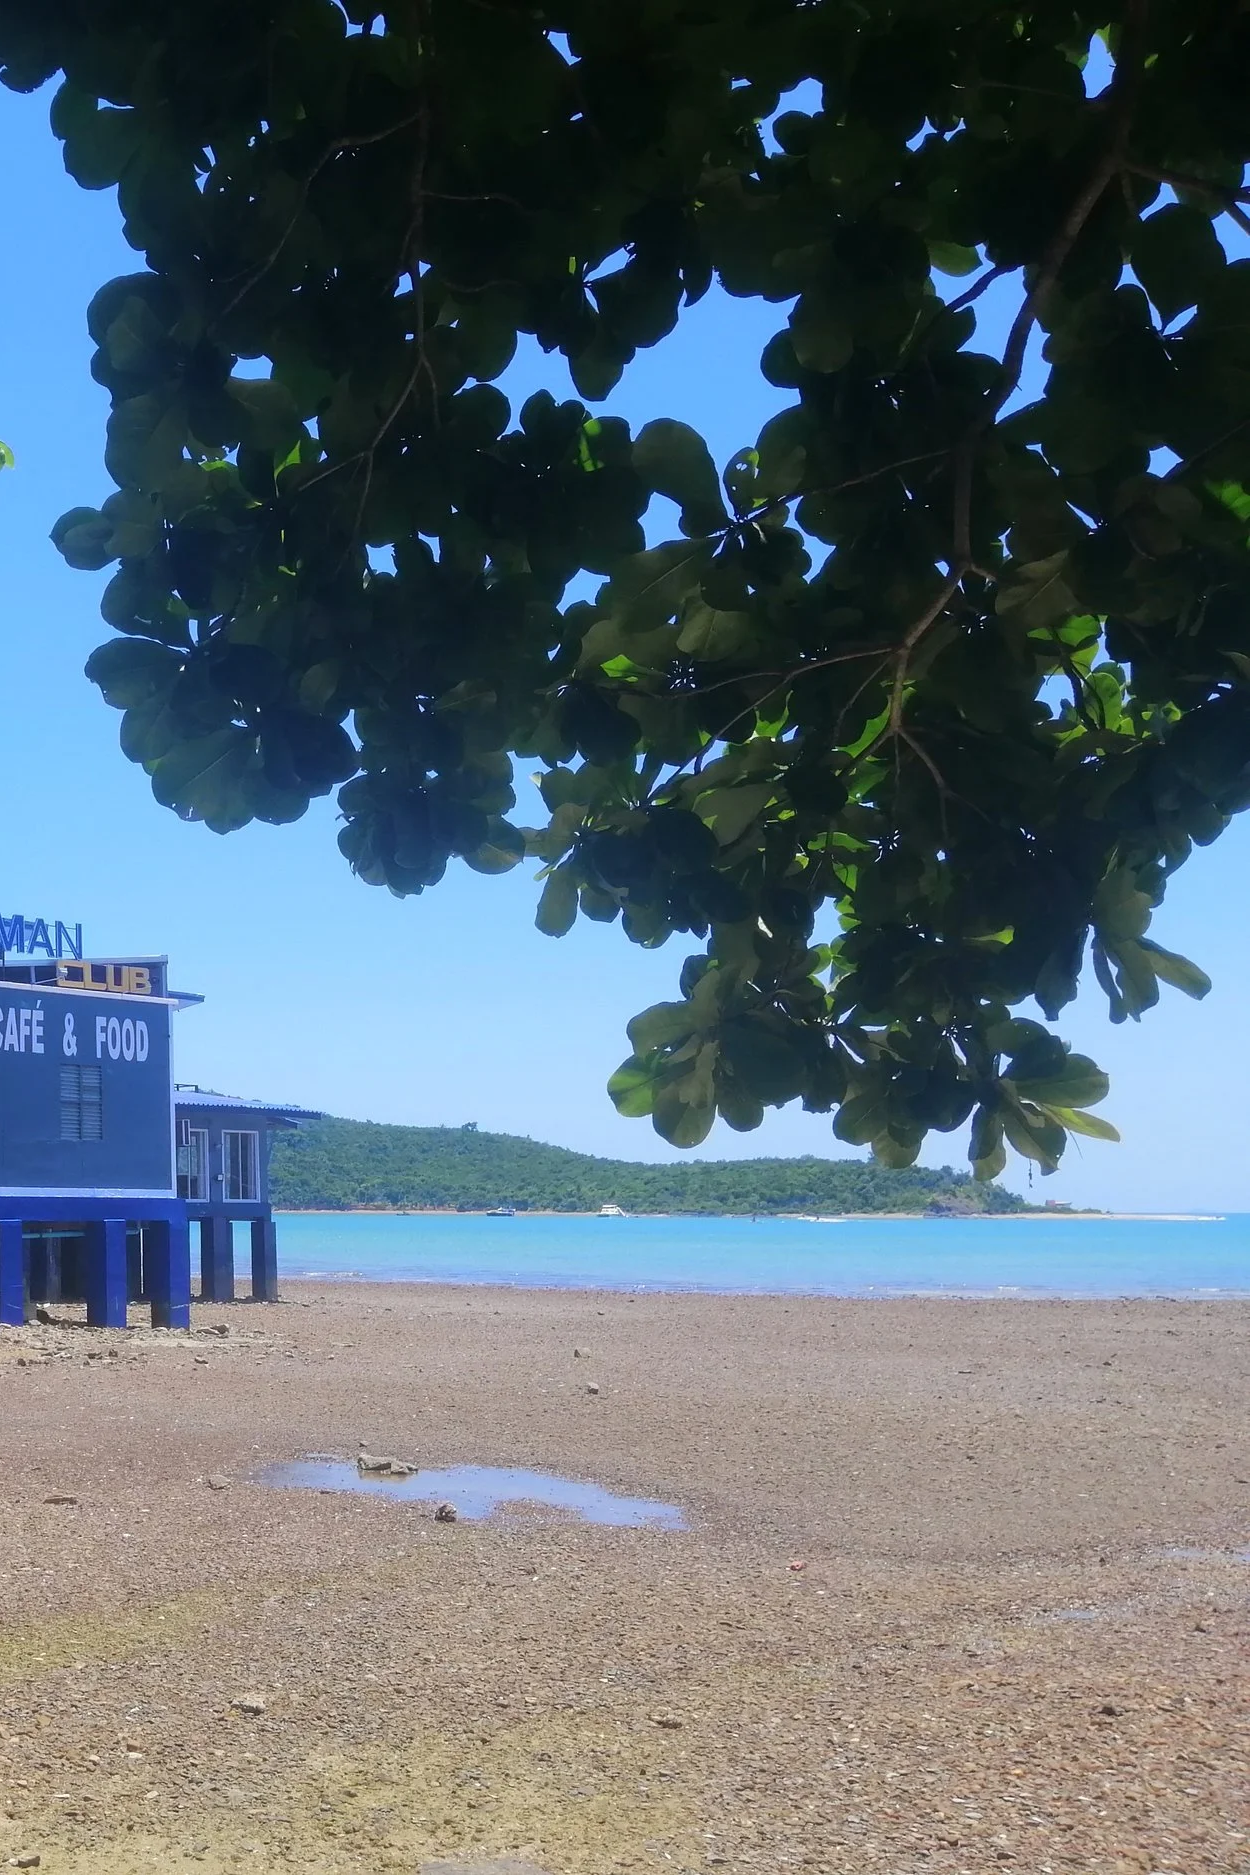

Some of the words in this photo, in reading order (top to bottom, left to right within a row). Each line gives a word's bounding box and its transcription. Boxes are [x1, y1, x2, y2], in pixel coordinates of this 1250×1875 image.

[56, 961, 152, 994] CLUB
[63, 1013, 77, 1056] &
[96, 1017, 149, 1061] FOOD
